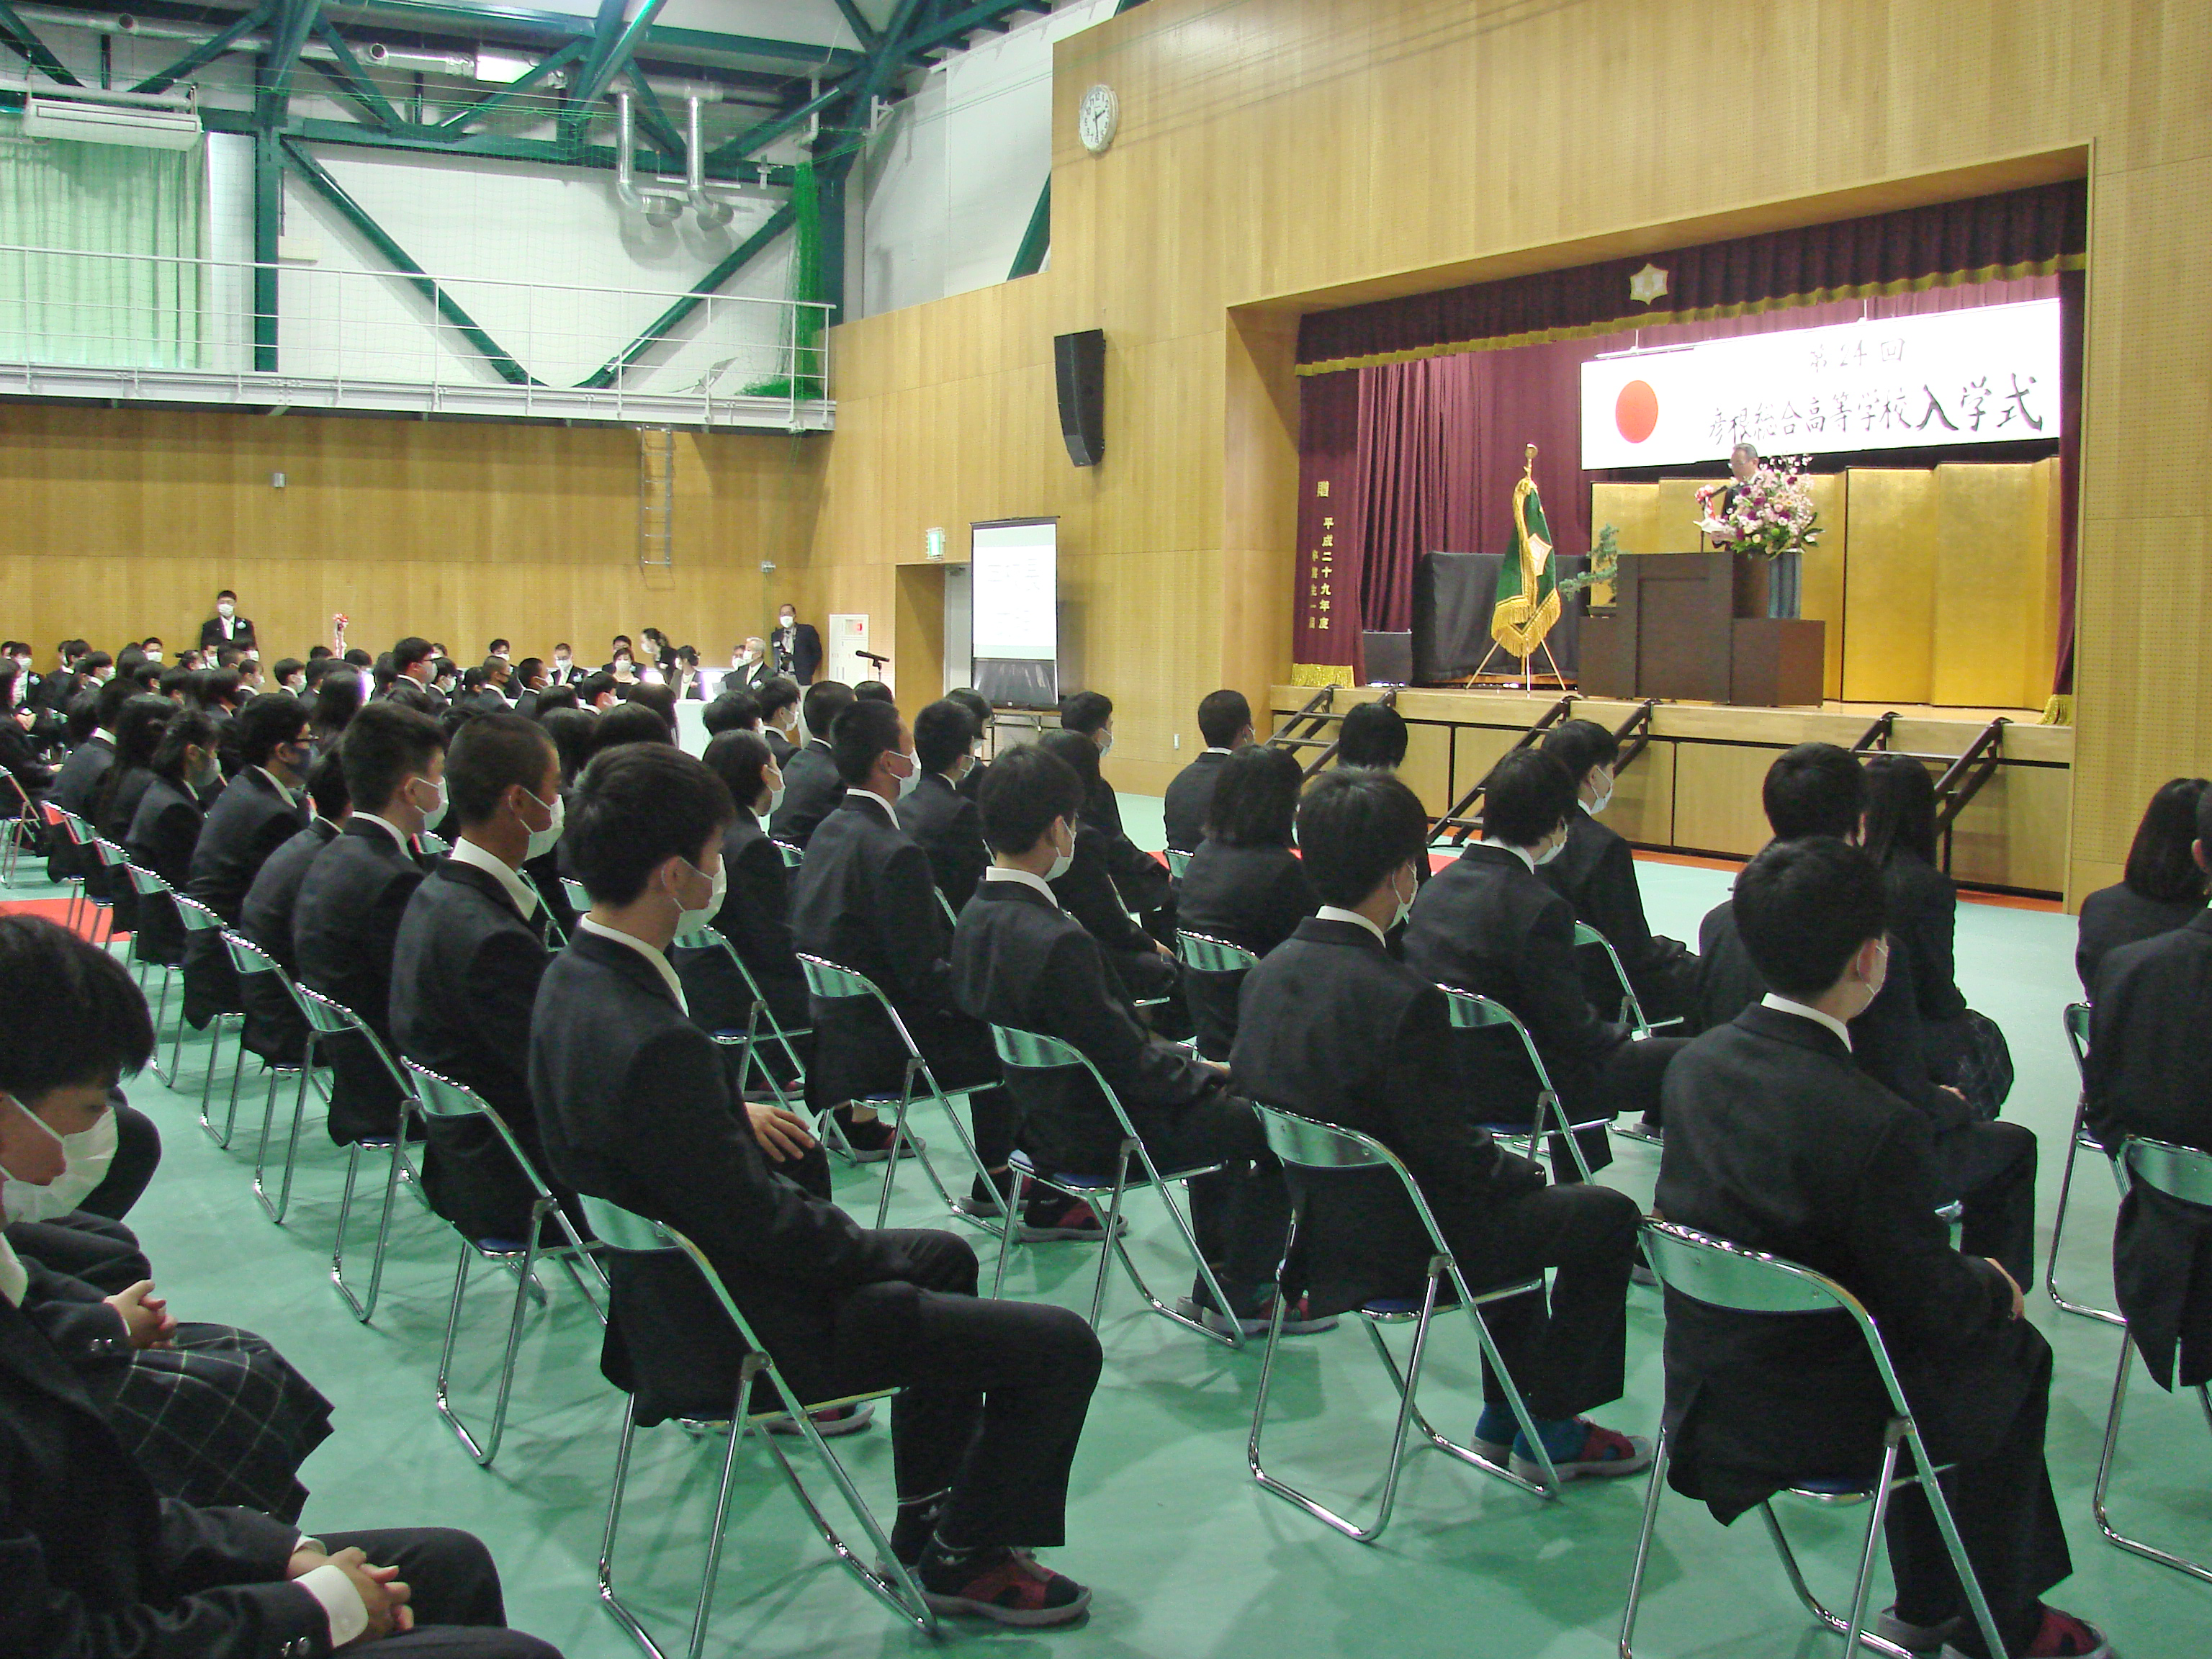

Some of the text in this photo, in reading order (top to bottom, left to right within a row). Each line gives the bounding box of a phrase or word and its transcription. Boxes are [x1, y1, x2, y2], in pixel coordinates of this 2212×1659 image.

[1809, 338, 1906, 373] 第24回
[1318, 516, 1334, 630] 平成二十九年度
